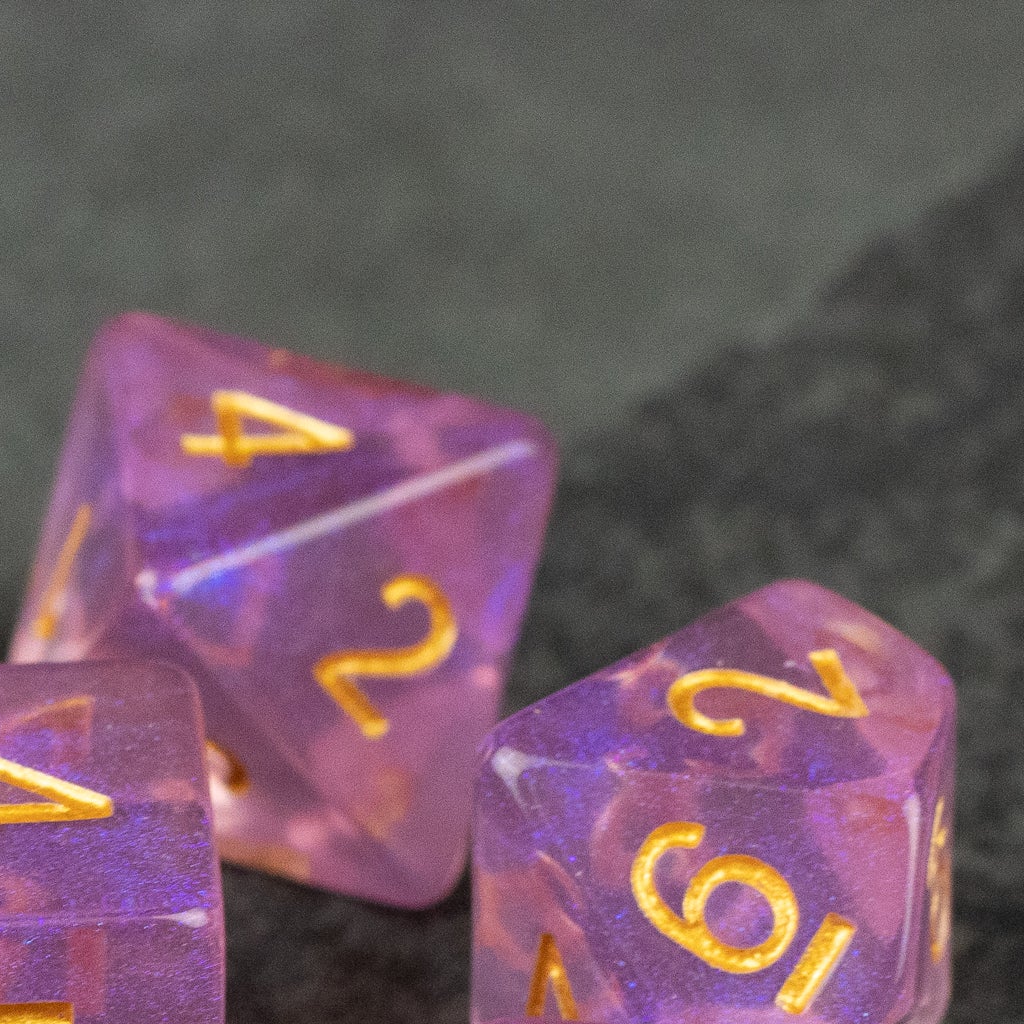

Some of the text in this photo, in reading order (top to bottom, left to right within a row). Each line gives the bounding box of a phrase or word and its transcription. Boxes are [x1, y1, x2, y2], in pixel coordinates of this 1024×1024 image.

[181, 391, 353, 467] 4
[313, 574, 457, 740] 2
[667, 649, 868, 737] 2
